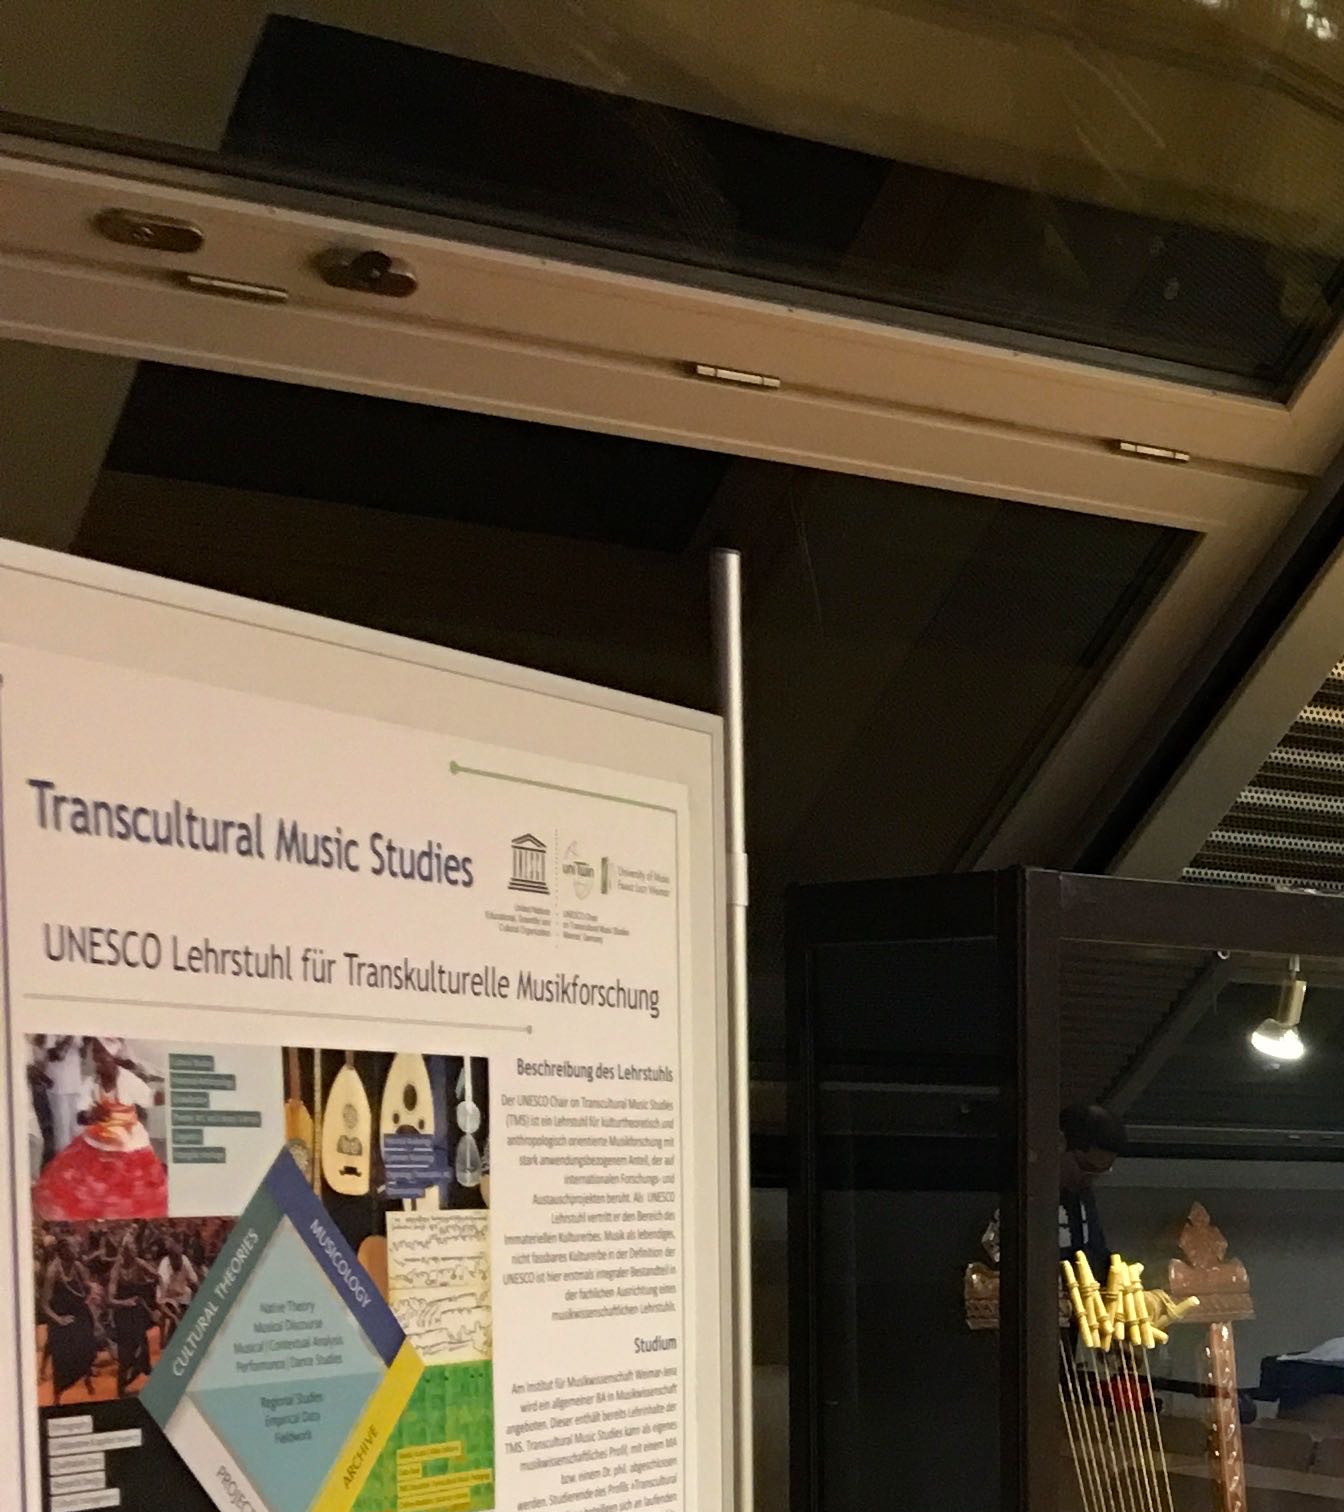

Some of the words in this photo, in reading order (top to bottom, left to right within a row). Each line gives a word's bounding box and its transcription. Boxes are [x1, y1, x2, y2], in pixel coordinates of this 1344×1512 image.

[26, 779, 265, 860] Transcultural
[276, 817, 360, 872] Music
[370, 832, 474, 888] Studies
[44, 923, 161, 969] UNESCO
[172, 936, 291, 980] Lehrstuhl
[301, 946, 336, 984] für
[344, 951, 510, 999] Transkulturelle
[517, 969, 660, 1019] Musikforschung
[516, 1057, 593, 1082] Beschreibung
[595, 1062, 614, 1080] des
[617, 1063, 672, 1082] Lehrstuhls
[173, 1303, 218, 1377] CULTURAL
[216, 1228, 260, 1301] THEORIES
[310, 1217, 371, 1309] MUSICOLOGY
[633, 1335, 676, 1354] Studium
[342, 1424, 380, 1490] ARCHIVE
